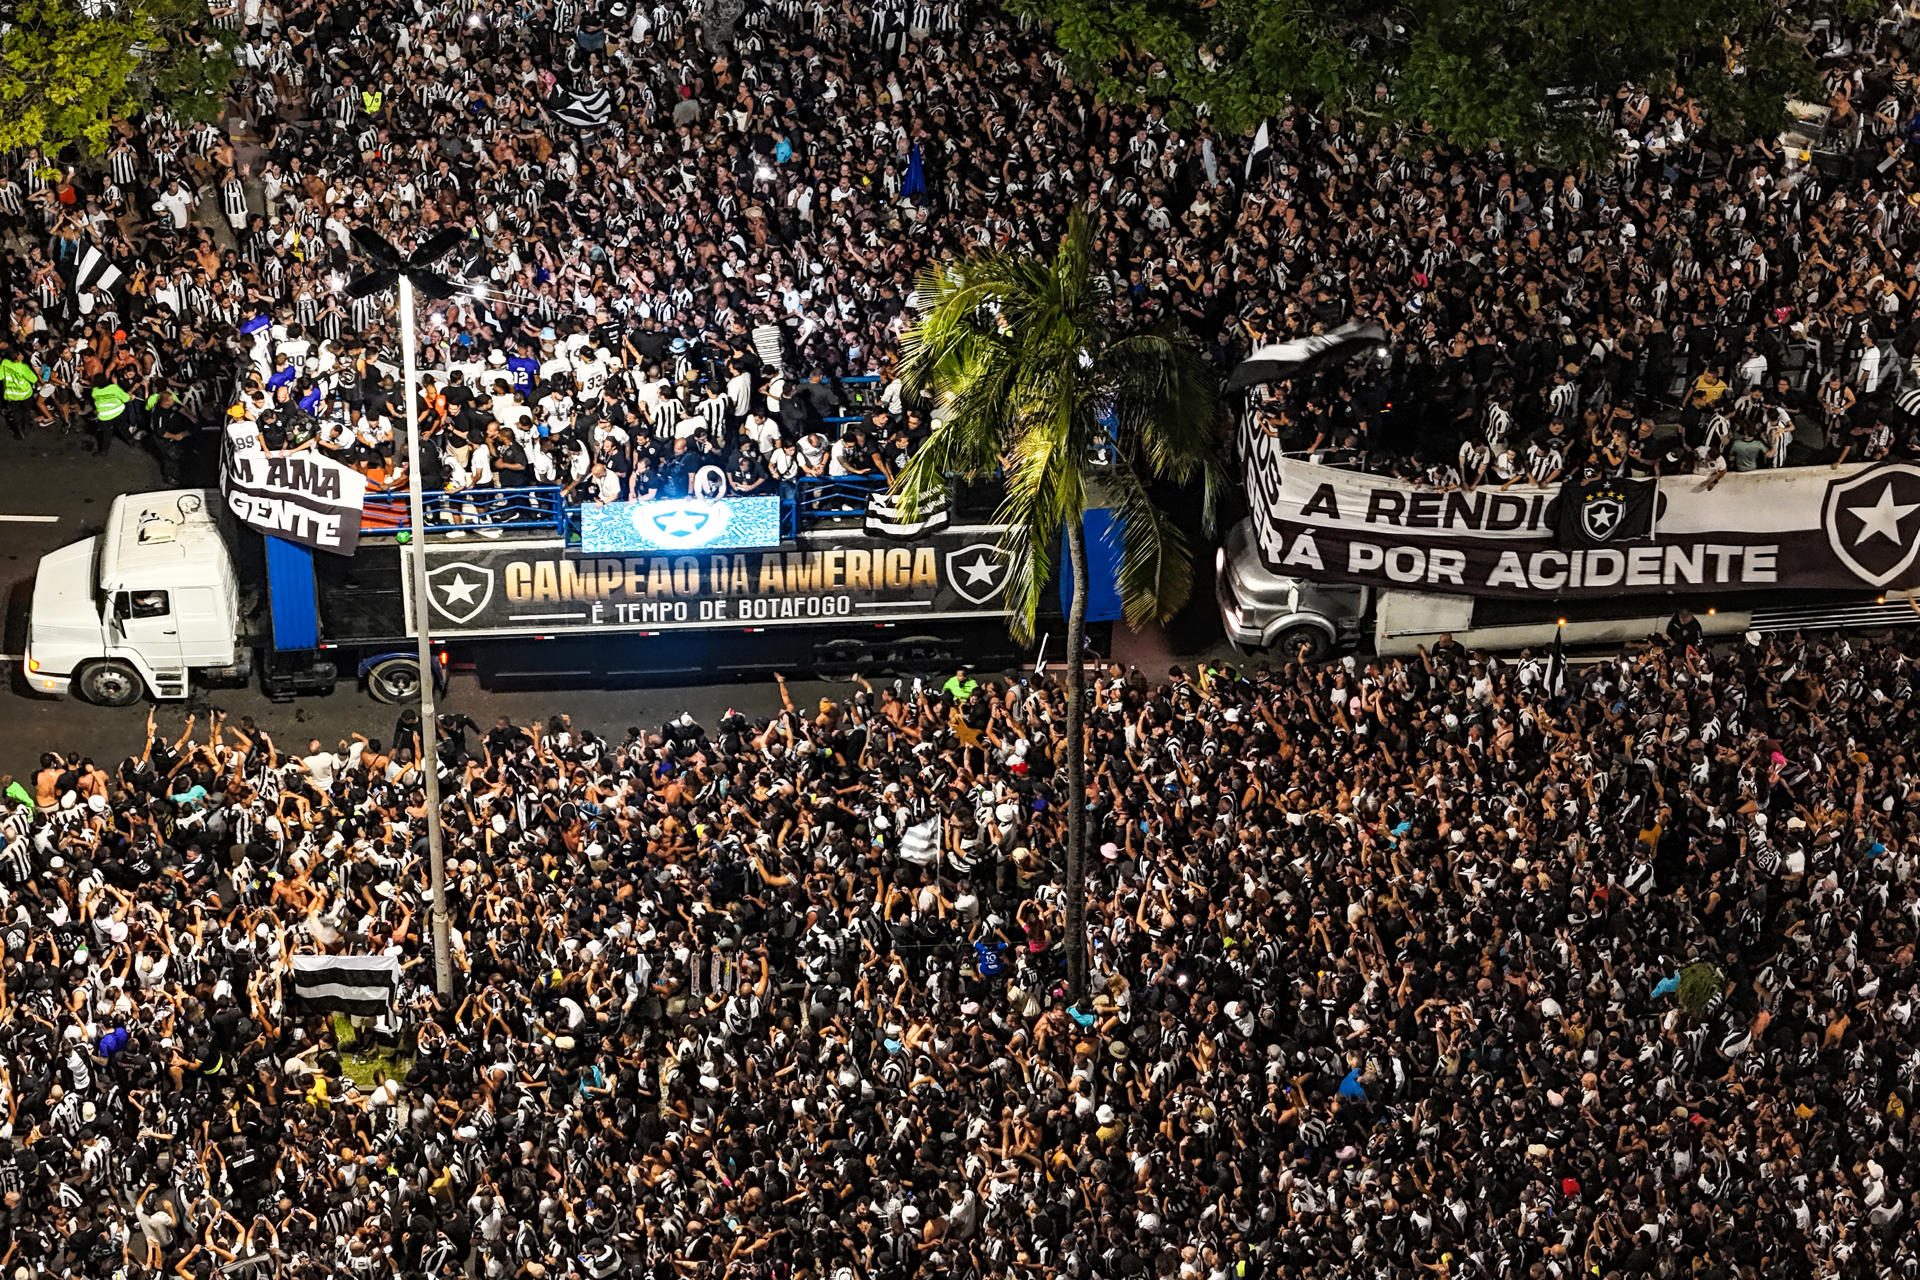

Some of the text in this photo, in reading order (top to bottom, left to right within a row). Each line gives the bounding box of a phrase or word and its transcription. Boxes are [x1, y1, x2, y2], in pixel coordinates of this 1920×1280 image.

[514, 372, 529, 385] 12
[587, 374, 603, 390] 33
[236, 435, 254, 449] 99
[266, 458, 341, 500] AMA
[229, 489, 341, 546] GENTE
[1300, 482, 1341, 519] A
[710, 553, 750, 595] DA
[758, 546, 938, 595] AMÉRICA
[1347, 540, 1467, 585] POR
[1485, 544, 1780, 590] ACIDENTE
[591, 595, 851, 624] É TEMPO DE BOTAFOGO
